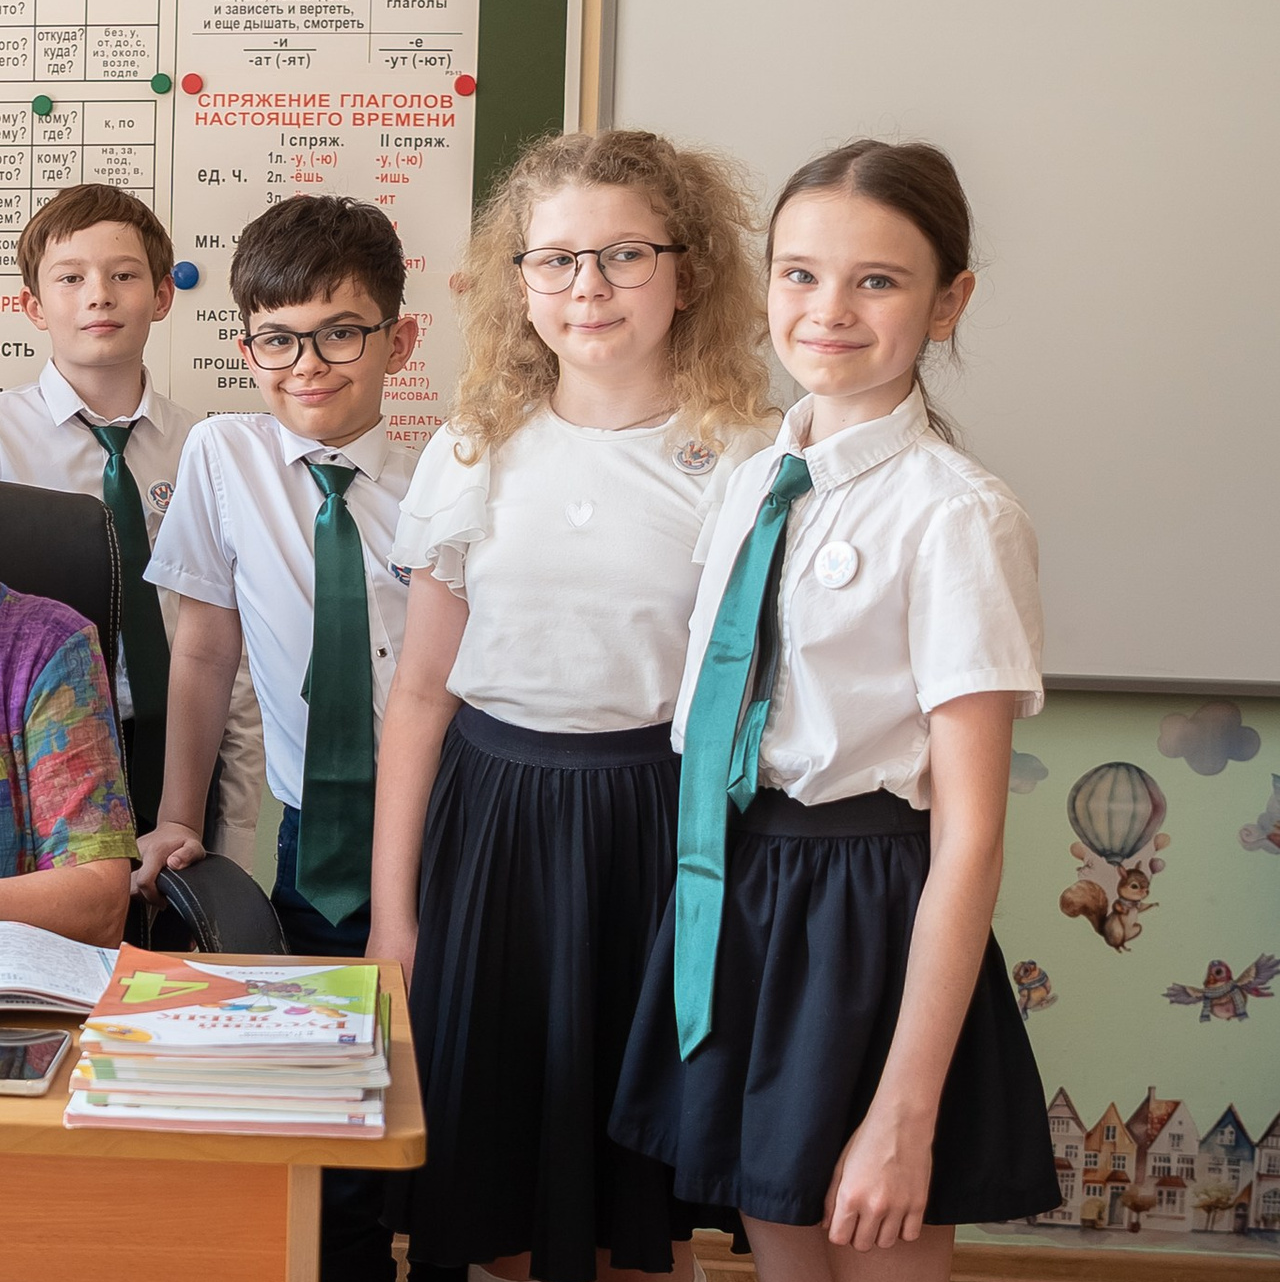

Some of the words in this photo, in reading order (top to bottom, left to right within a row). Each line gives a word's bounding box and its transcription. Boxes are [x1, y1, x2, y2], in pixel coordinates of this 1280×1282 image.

[225, 4, 283, 15] зависеть
[299, 3, 354, 17] вертеть,
[215, 19, 240, 31] еще
[244, 17, 299, 31] дышать,
[304, 17, 364, 31] смотреть
[37, 29, 84, 43] откуда?
[43, 44, 78, 60] куда?
[112, 50, 149, 58] около,
[47, 60, 74, 75] где?
[198, 94, 330, 109] СПРЯЖЕНИЕ
[339, 94, 454, 111] ГЛАГОЛОВ
[38, 111, 78, 125] кому?
[118, 119, 134, 130] по
[194, 112, 343, 128] НАСТОЯЩЕГО
[352, 113, 455, 127] ВРЕМЕНИ
[43, 127, 72, 141] где?
[289, 135, 344, 150] спряж.
[395, 137, 450, 151] спряж.
[37, 151, 77, 165] кому?
[42, 167, 71, 182] где?
[94, 168, 130, 176] через,
[198, 169, 225, 185] ед.
[375, 173, 410, 184] -ишь
[109, 178, 129, 187] про
[389, 416, 442, 426] ДЕЛАТЬ
[119, 971, 209, 1003] 4
